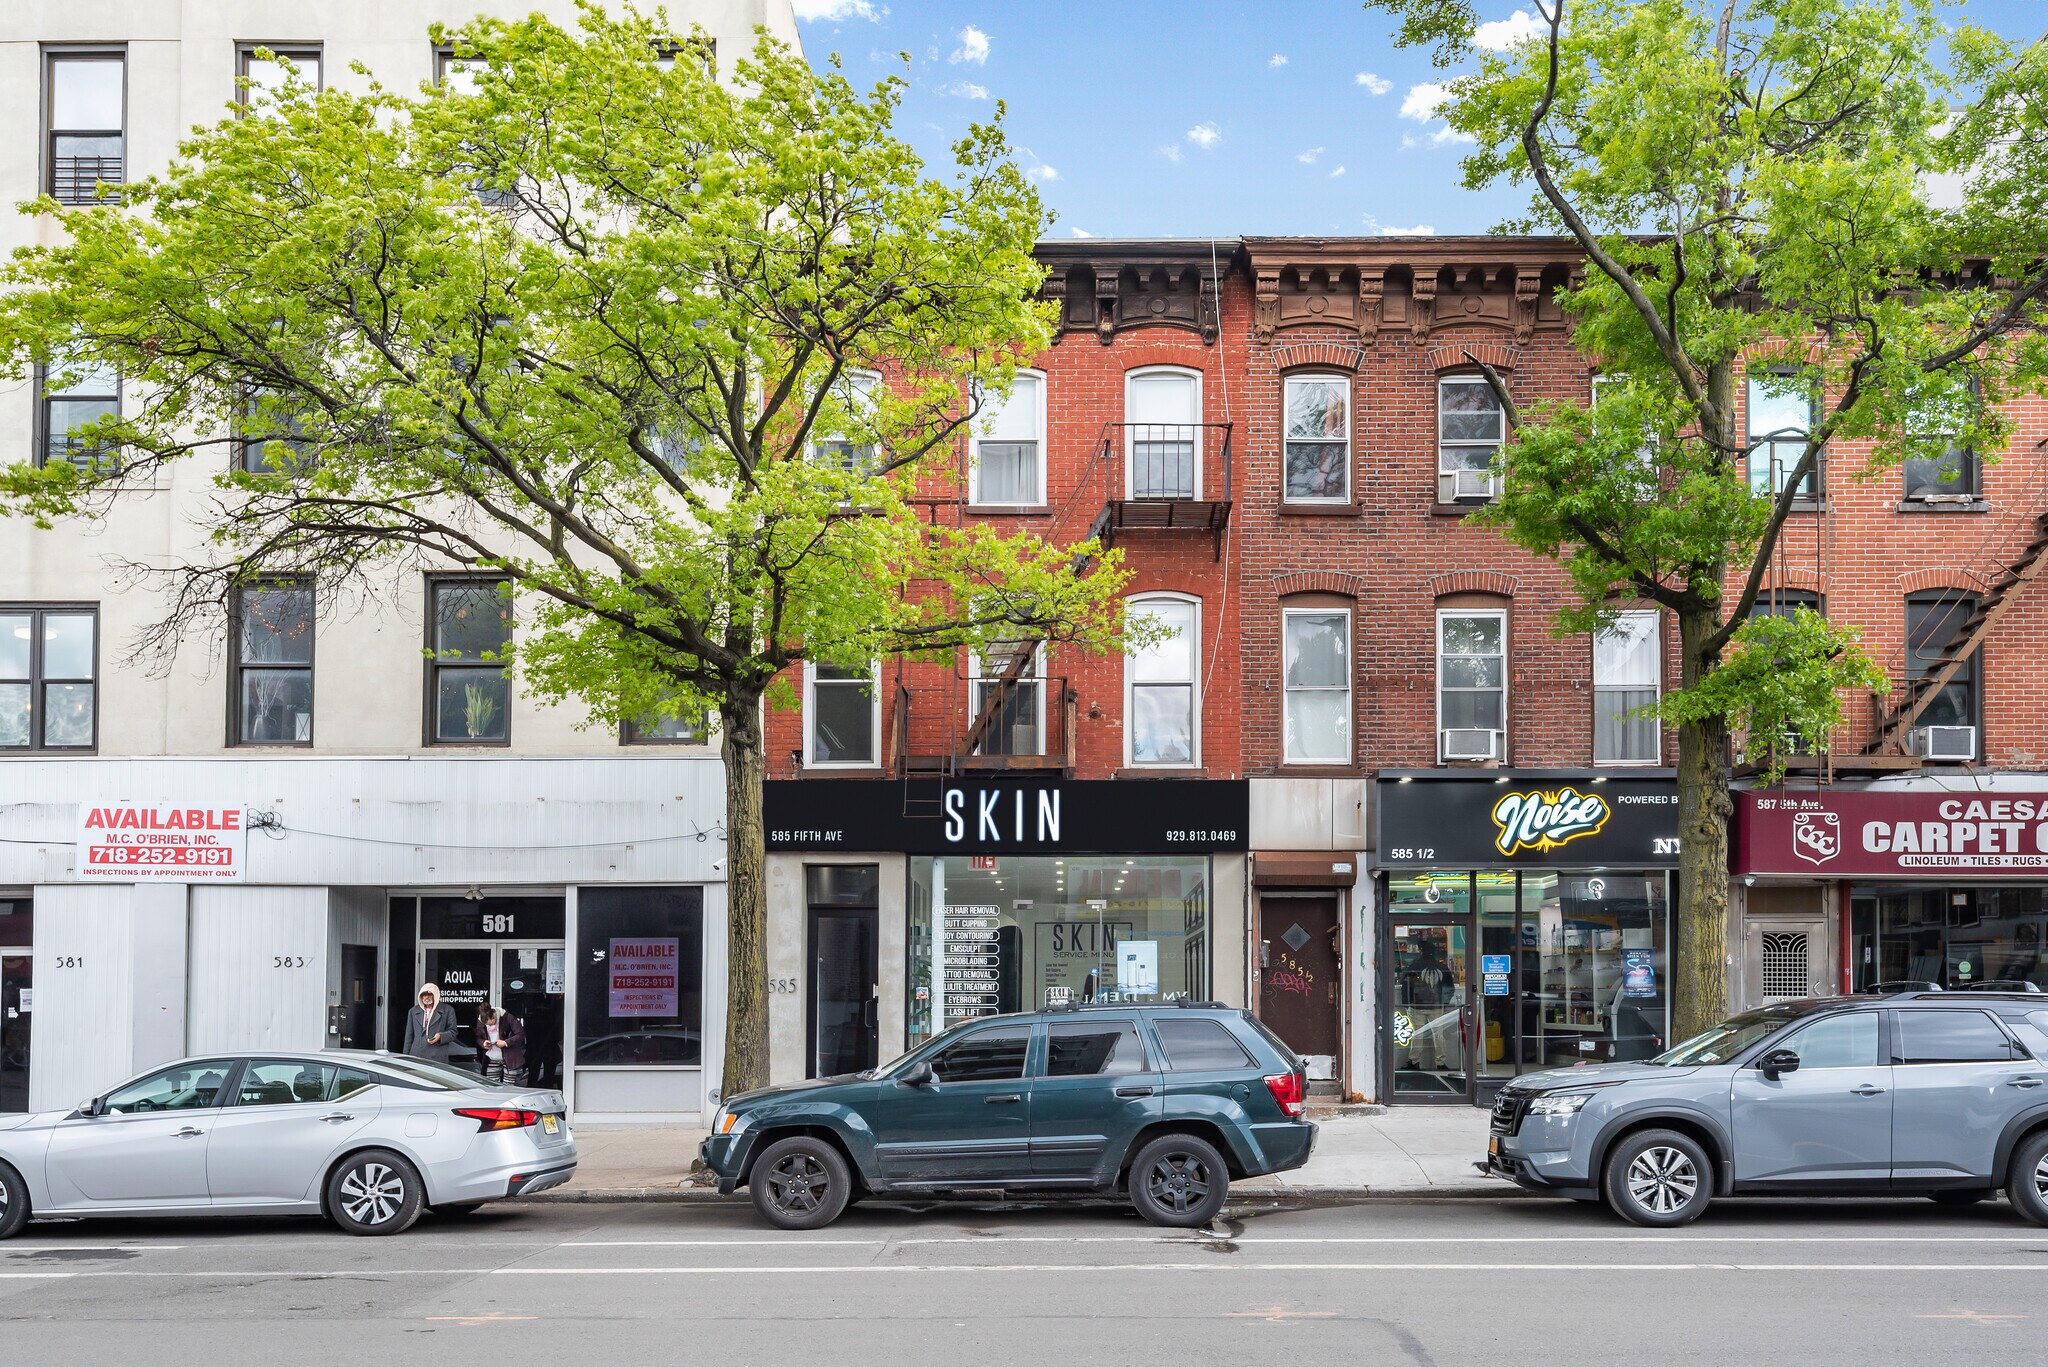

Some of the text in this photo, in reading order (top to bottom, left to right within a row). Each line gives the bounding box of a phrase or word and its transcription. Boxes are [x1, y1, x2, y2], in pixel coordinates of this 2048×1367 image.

[1618, 795, 1679, 804] POWERED B
[1757, 799, 1777, 810] 587
[84, 808, 240, 831] AVAILABLE
[944, 789, 1061, 842] SKIN
[1495, 788, 1606, 850] Noise
[106, 833, 219, 846] M.C. O'BRIEN, INC.
[771, 830, 843, 841] 585 FIFTH AVE
[1166, 830, 1237, 842] 929.813.0469
[1862, 821, 2026, 854] CARPET
[92, 847, 229, 864] 718-252-9191
[1391, 849, 1434, 859] 585 1/2
[1904, 856, 2042, 866] LINOLEUM TILES RUGS
[954, 907, 969, 915] HAIR
[969, 907, 997, 915] REMOVAL
[482, 914, 514, 933] 581
[939, 932, 994, 940] BODY CONTOURING
[1053, 924, 1115, 951] SKIN
[613, 945, 675, 957] AVAILABLE
[950, 945, 981, 953] EMSCULPT
[55, 957, 84, 968] 581
[943, 957, 988, 965] MICROBLADING
[444, 971, 473, 983] AQUA
[939, 971, 992, 979] TATTOO REMOVAL
[616, 978, 672, 986] 718-252-9191
[769, 978, 796, 993] 585
[963, 983, 996, 991] TREATMENT
[1050, 987, 1069, 996] SKIN
[948, 996, 982, 1004] EYEBROWS
[949, 1008, 980, 1016] LASH LIFT
